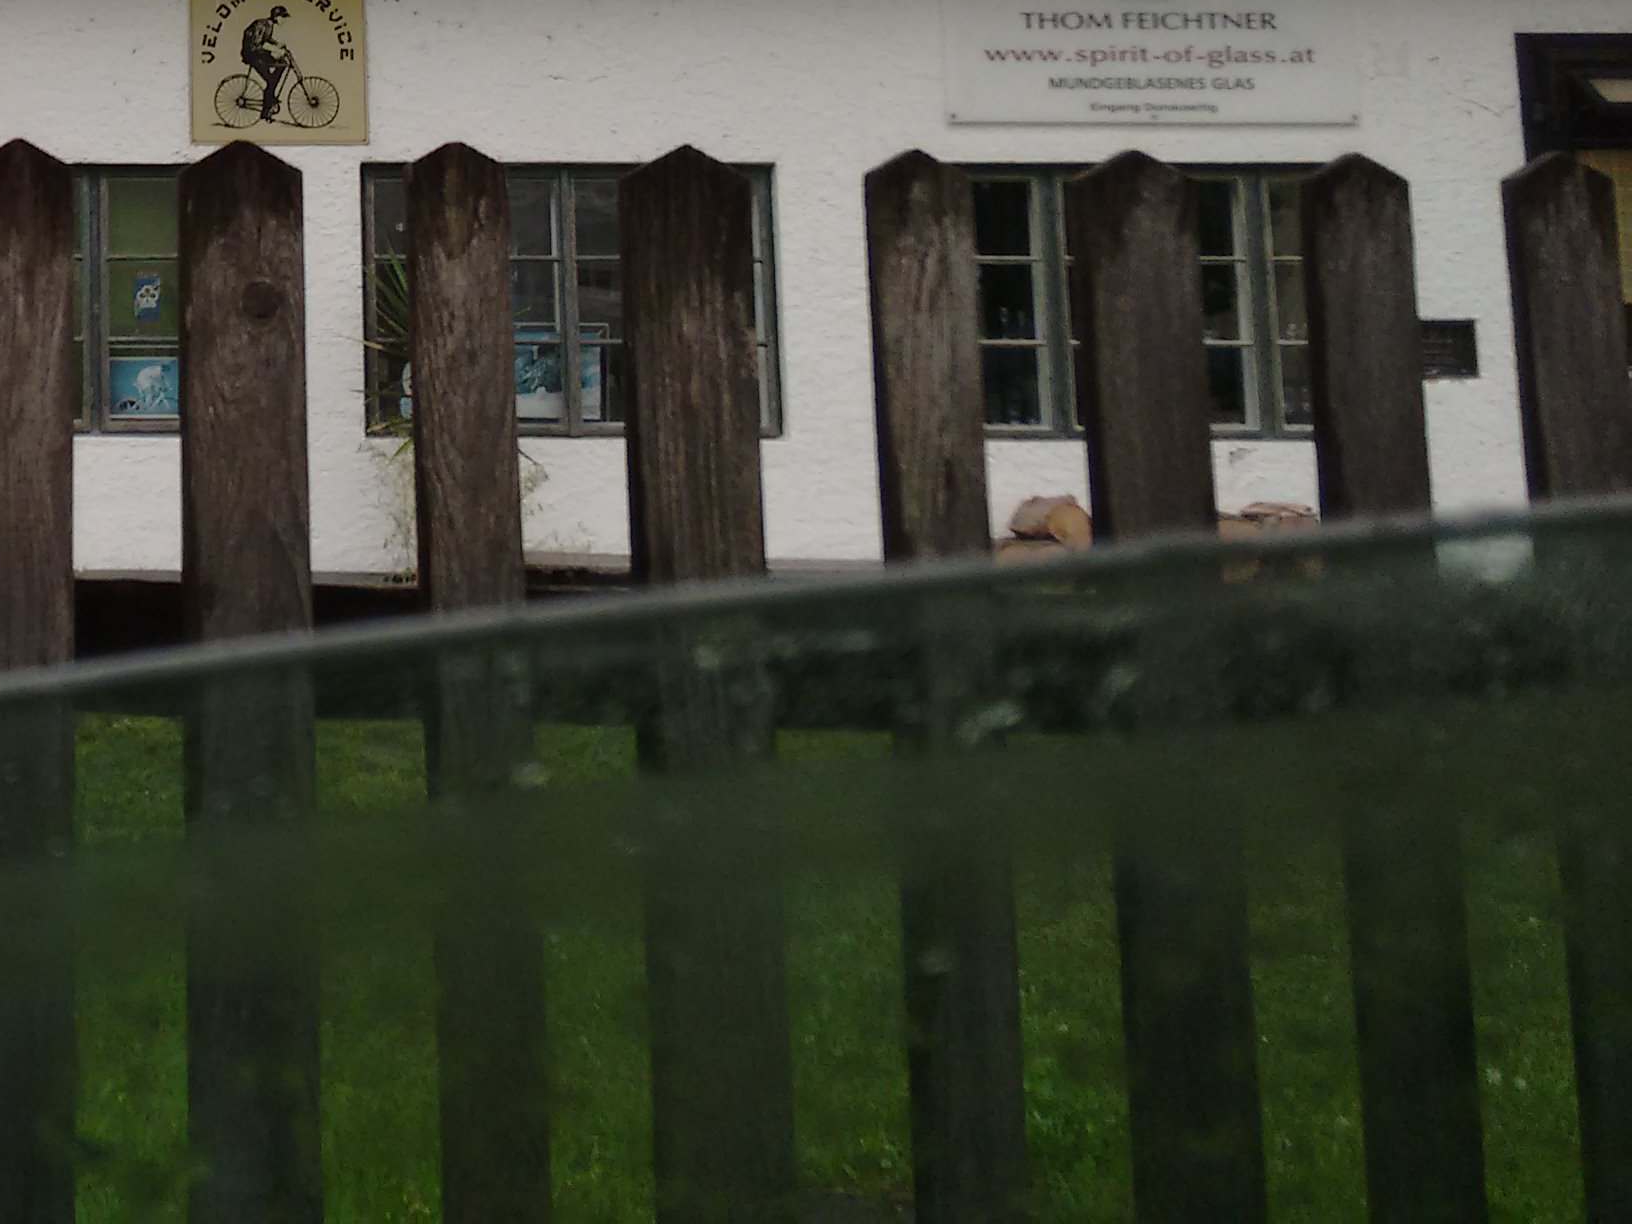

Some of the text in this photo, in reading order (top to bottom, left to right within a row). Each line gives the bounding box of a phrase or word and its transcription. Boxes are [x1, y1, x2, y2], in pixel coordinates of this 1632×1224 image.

[1020, 11, 1277, 30] THOM FEICHTNER
[984, 45, 1316, 69] www.spirit-of-glass.at
[1048, 77, 1256, 90] MUNDGEBLASENES GLAS
